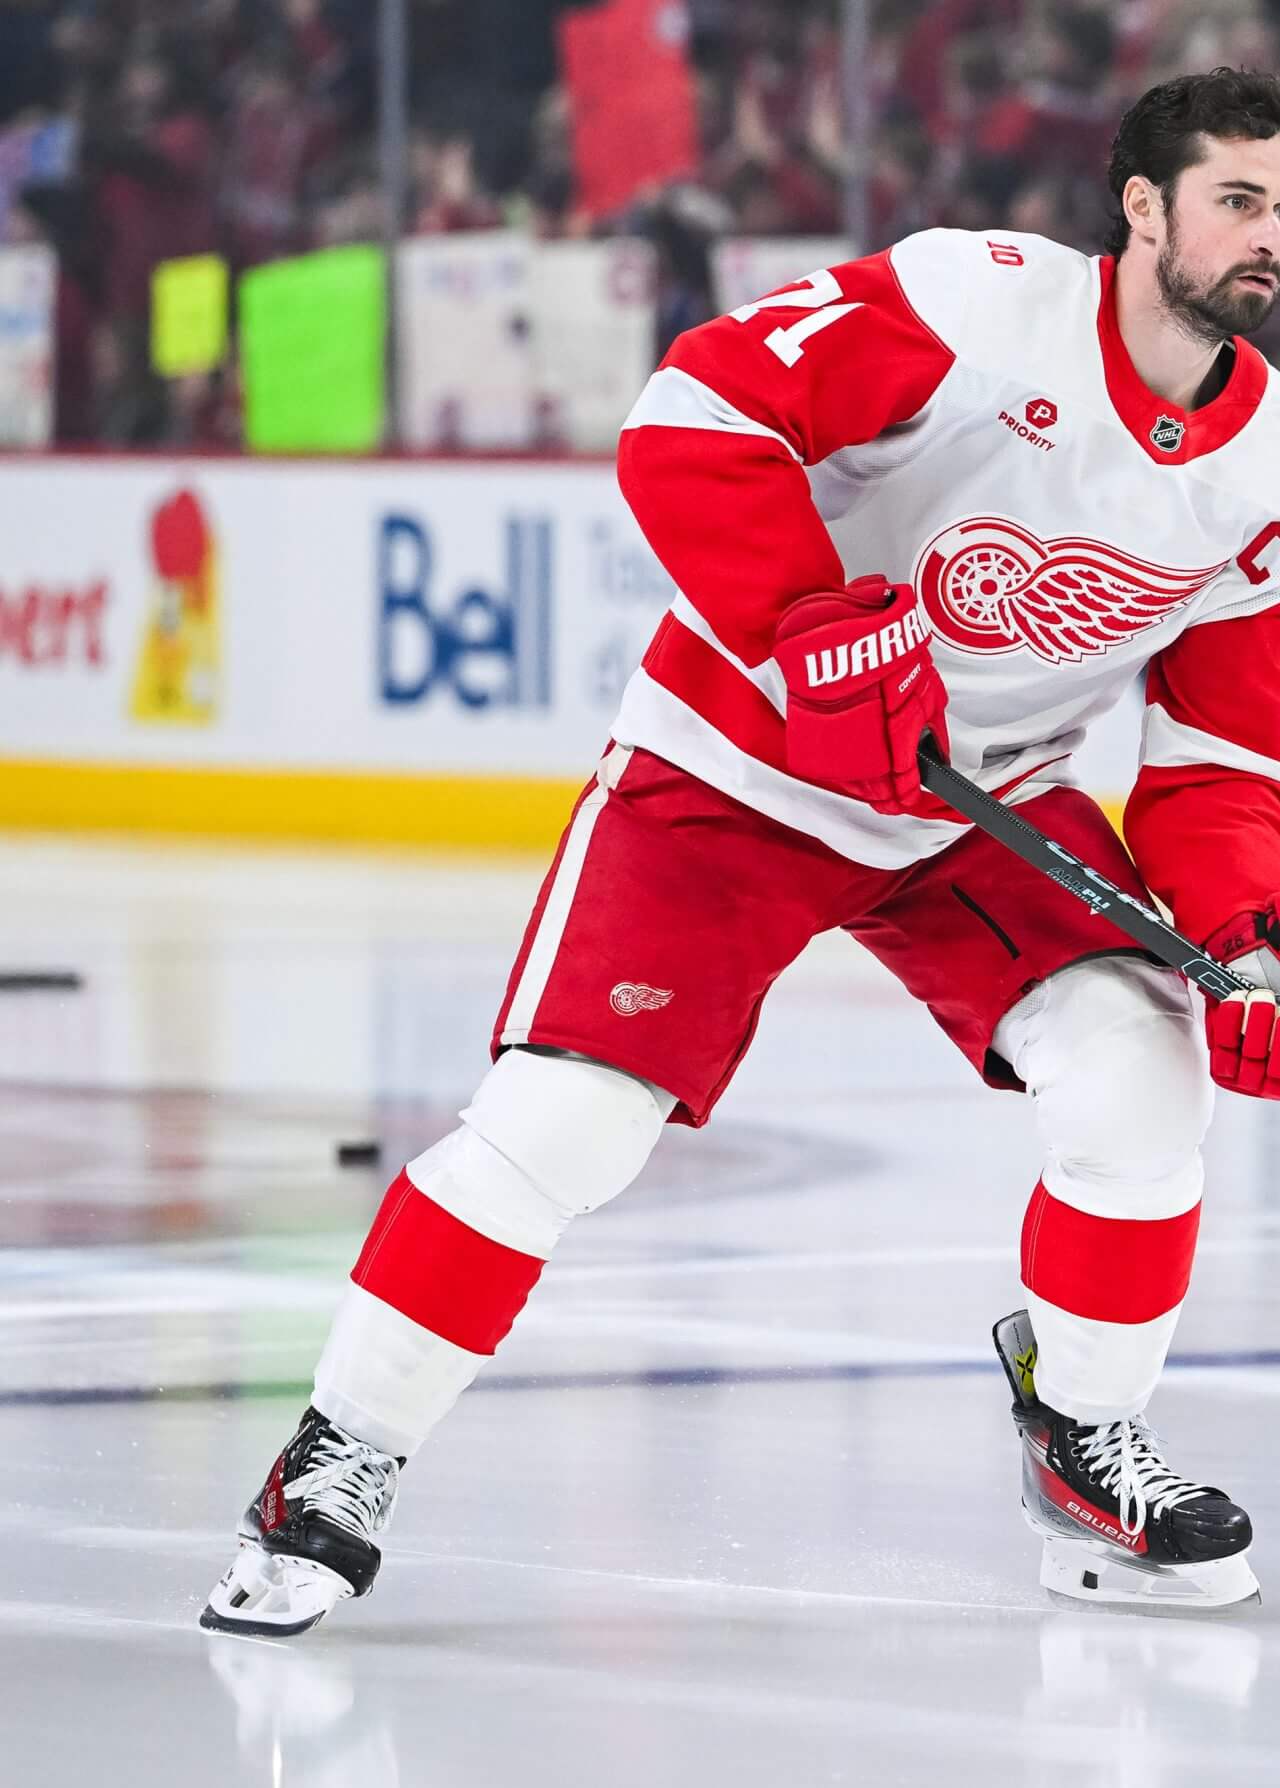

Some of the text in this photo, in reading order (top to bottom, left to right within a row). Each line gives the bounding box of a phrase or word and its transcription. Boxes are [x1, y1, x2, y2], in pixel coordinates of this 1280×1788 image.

[728, 268, 865, 368] 71
[998, 410, 1056, 452] PRIORITY
[1156, 427, 1178, 441] NHL
[378, 515, 554, 710] Bell
